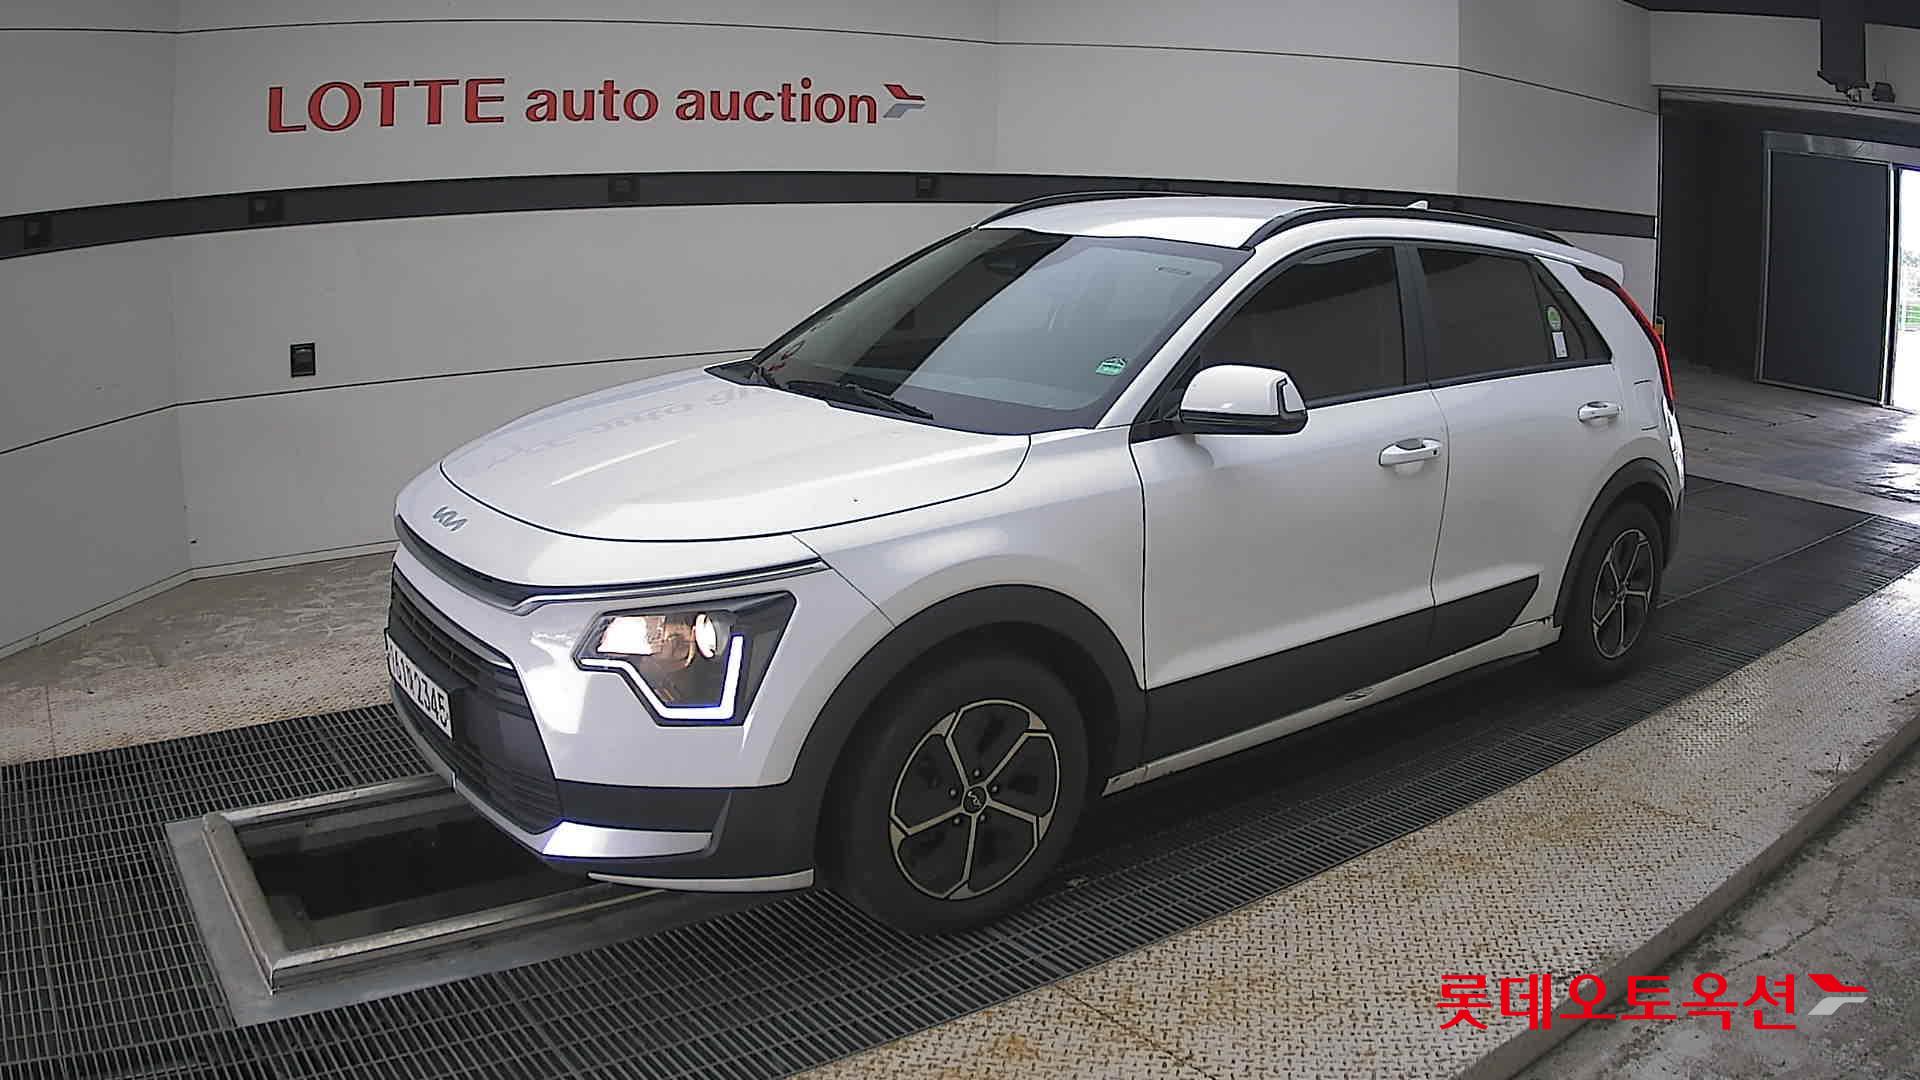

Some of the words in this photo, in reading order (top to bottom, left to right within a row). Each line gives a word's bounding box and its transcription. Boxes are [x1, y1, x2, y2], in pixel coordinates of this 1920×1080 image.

[267, 78, 505, 133] LOTTE
[525, 79, 659, 123] auto
[676, 78, 878, 123] auction
